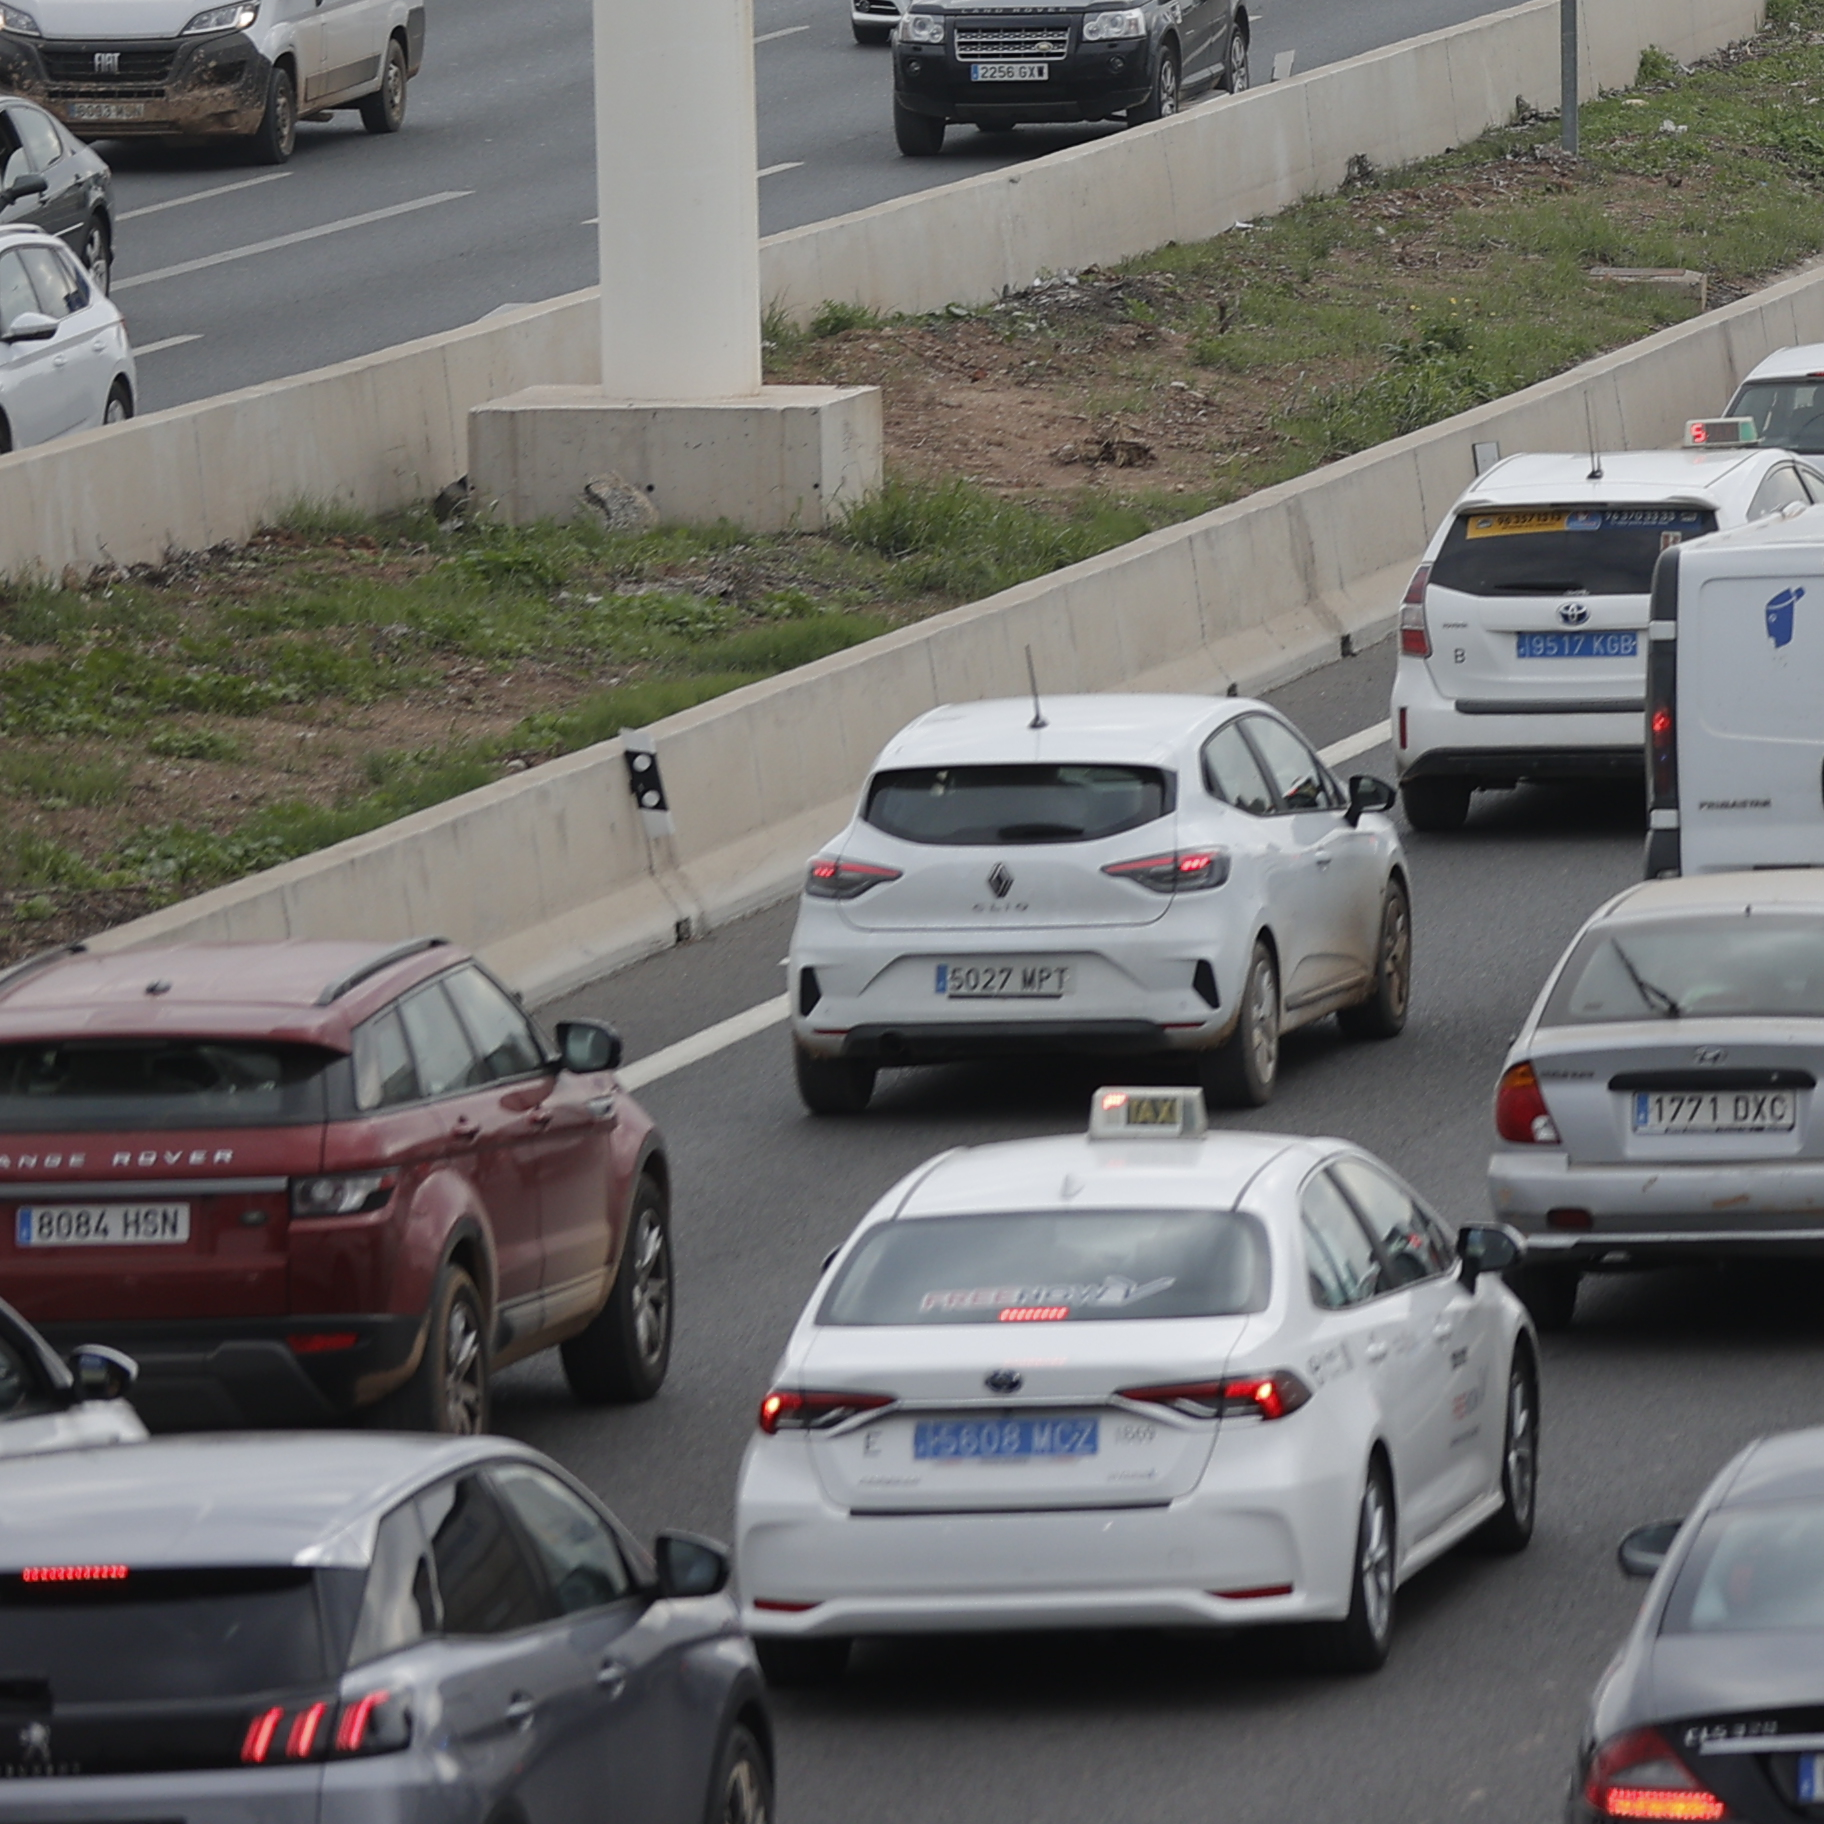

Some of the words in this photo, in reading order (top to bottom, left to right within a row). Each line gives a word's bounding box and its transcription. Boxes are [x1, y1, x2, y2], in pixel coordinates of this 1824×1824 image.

[94, 52, 122, 73] FIAT
[980, 64, 1014, 80] 2256
[1454, 648, 1467, 664] B
[1531, 633, 1583, 656] 9517
[1592, 632, 1635, 655] KGB
[949, 967, 1012, 993] 5027
[1020, 966, 1069, 992] MPT
[1128, 1098, 1178, 1125] TAXI
[1654, 1094, 1718, 1125] 1771
[1733, 1092, 1788, 1124] DXC
[112, 1148, 234, 1167] ROVER
[37, 1206, 110, 1240] 8084
[122, 1203, 180, 1238] HSN
[863, 1431, 882, 1456] E
[1031, 1420, 1098, 1453] MCZ
